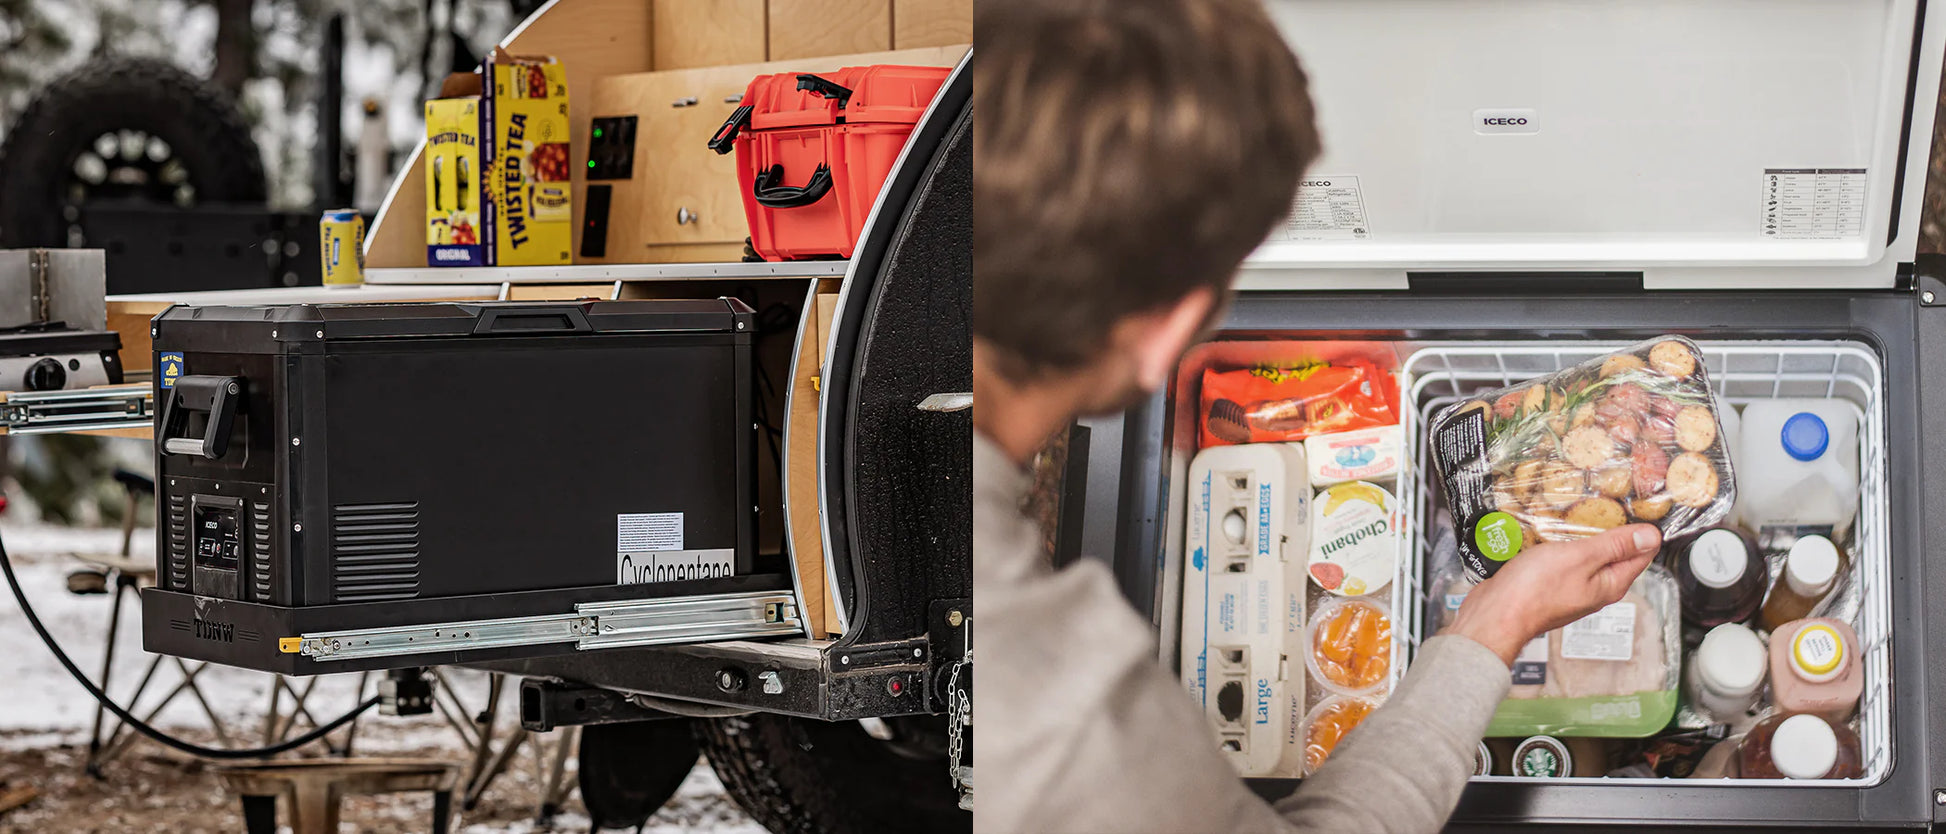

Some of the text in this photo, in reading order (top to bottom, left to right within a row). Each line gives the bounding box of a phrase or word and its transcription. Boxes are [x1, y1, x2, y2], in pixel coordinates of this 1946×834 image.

[505, 112, 528, 151] TEA
[1483, 117, 1528, 126] ICECO
[505, 156, 529, 250] TWISTED
[1259, 524, 1270, 551] GRADE
[1320, 519, 1388, 560] Chobani
[1487, 538, 1500, 554] go
[1491, 526, 1510, 554] fresh
[1468, 552, 1488, 577] store
[1255, 678, 1272, 725] Large
